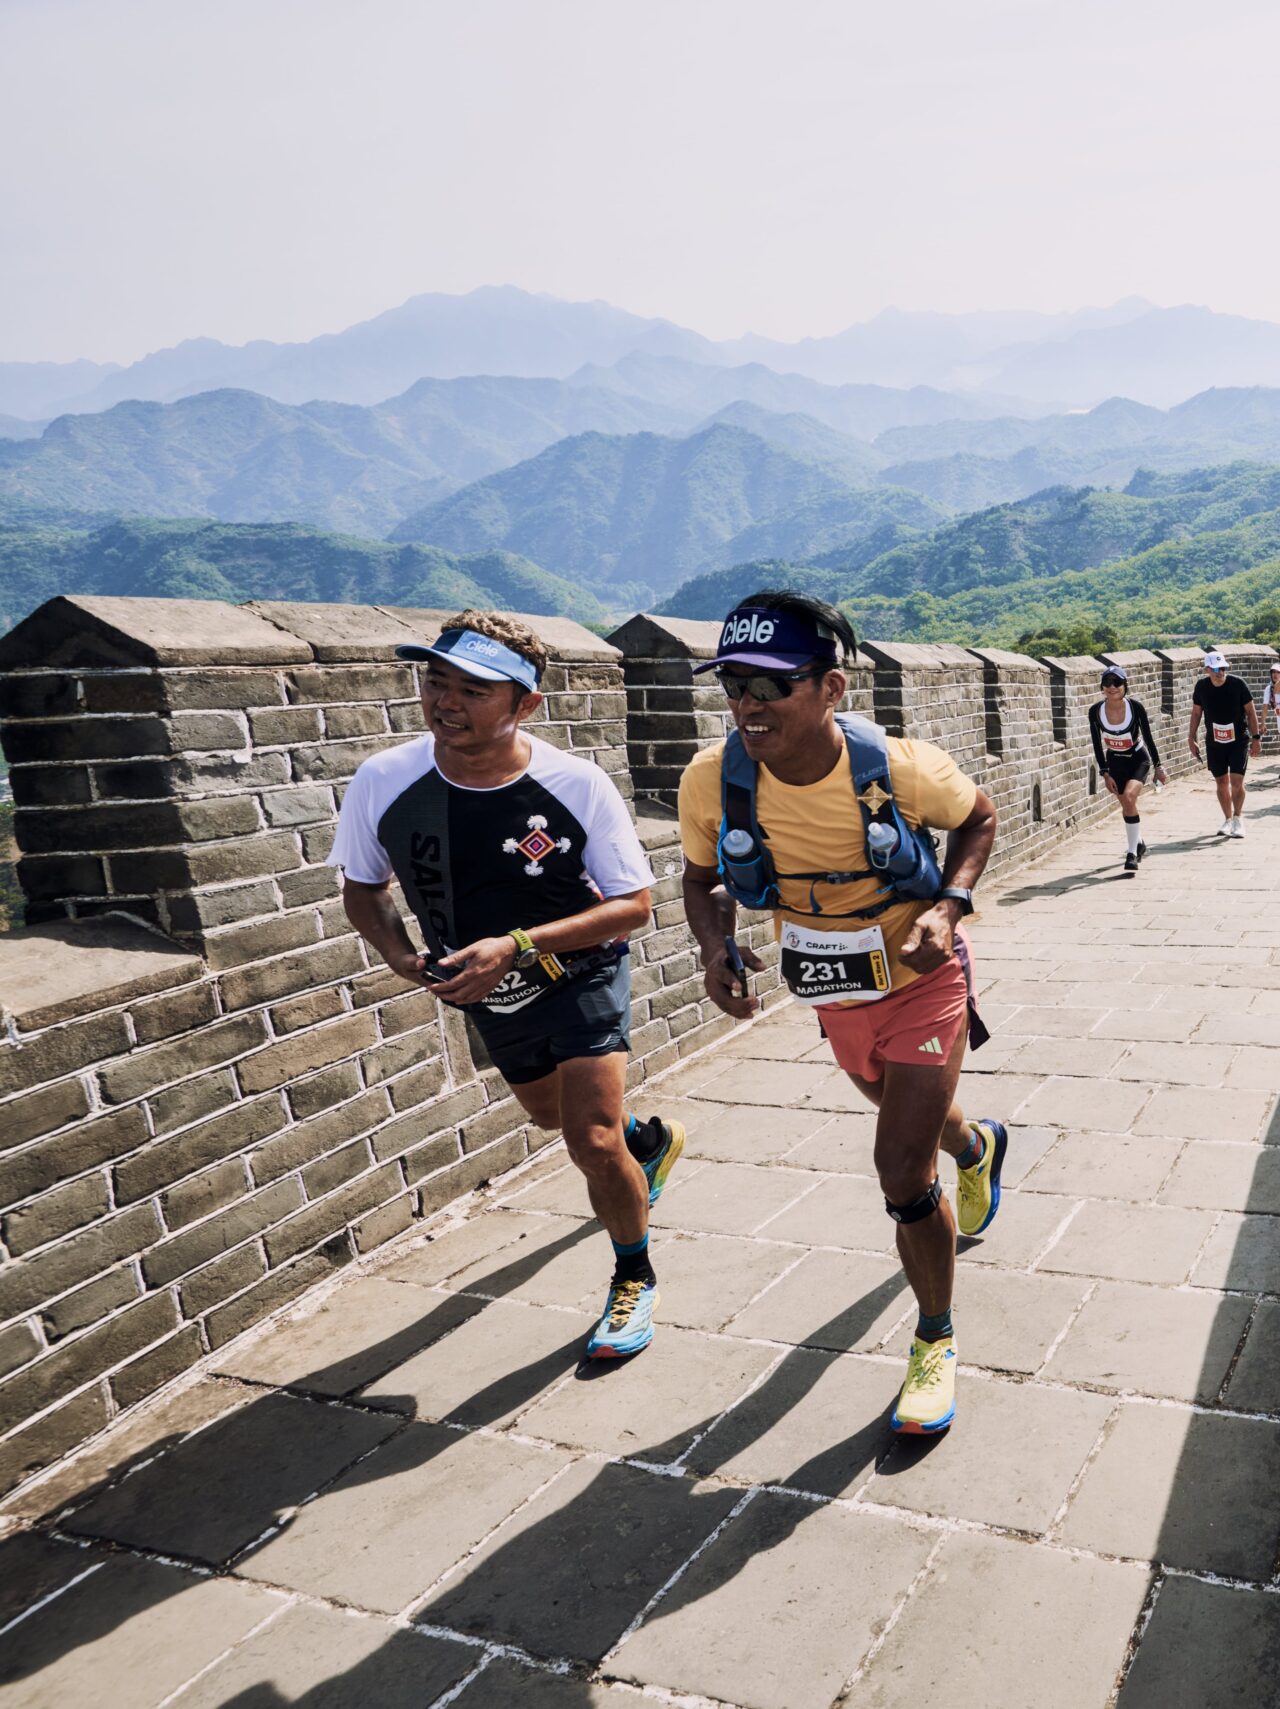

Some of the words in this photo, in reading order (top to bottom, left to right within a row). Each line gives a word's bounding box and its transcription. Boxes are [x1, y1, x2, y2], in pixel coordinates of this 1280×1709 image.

[466, 640, 498, 657] ciele
[410, 831, 449, 942] SALO
[805, 941, 838, 951] CRAFT
[799, 961, 848, 982] 231
[491, 970, 527, 994] 32
[796, 981, 862, 995] MARATHON
[481, 984, 541, 1004] MARATHON
